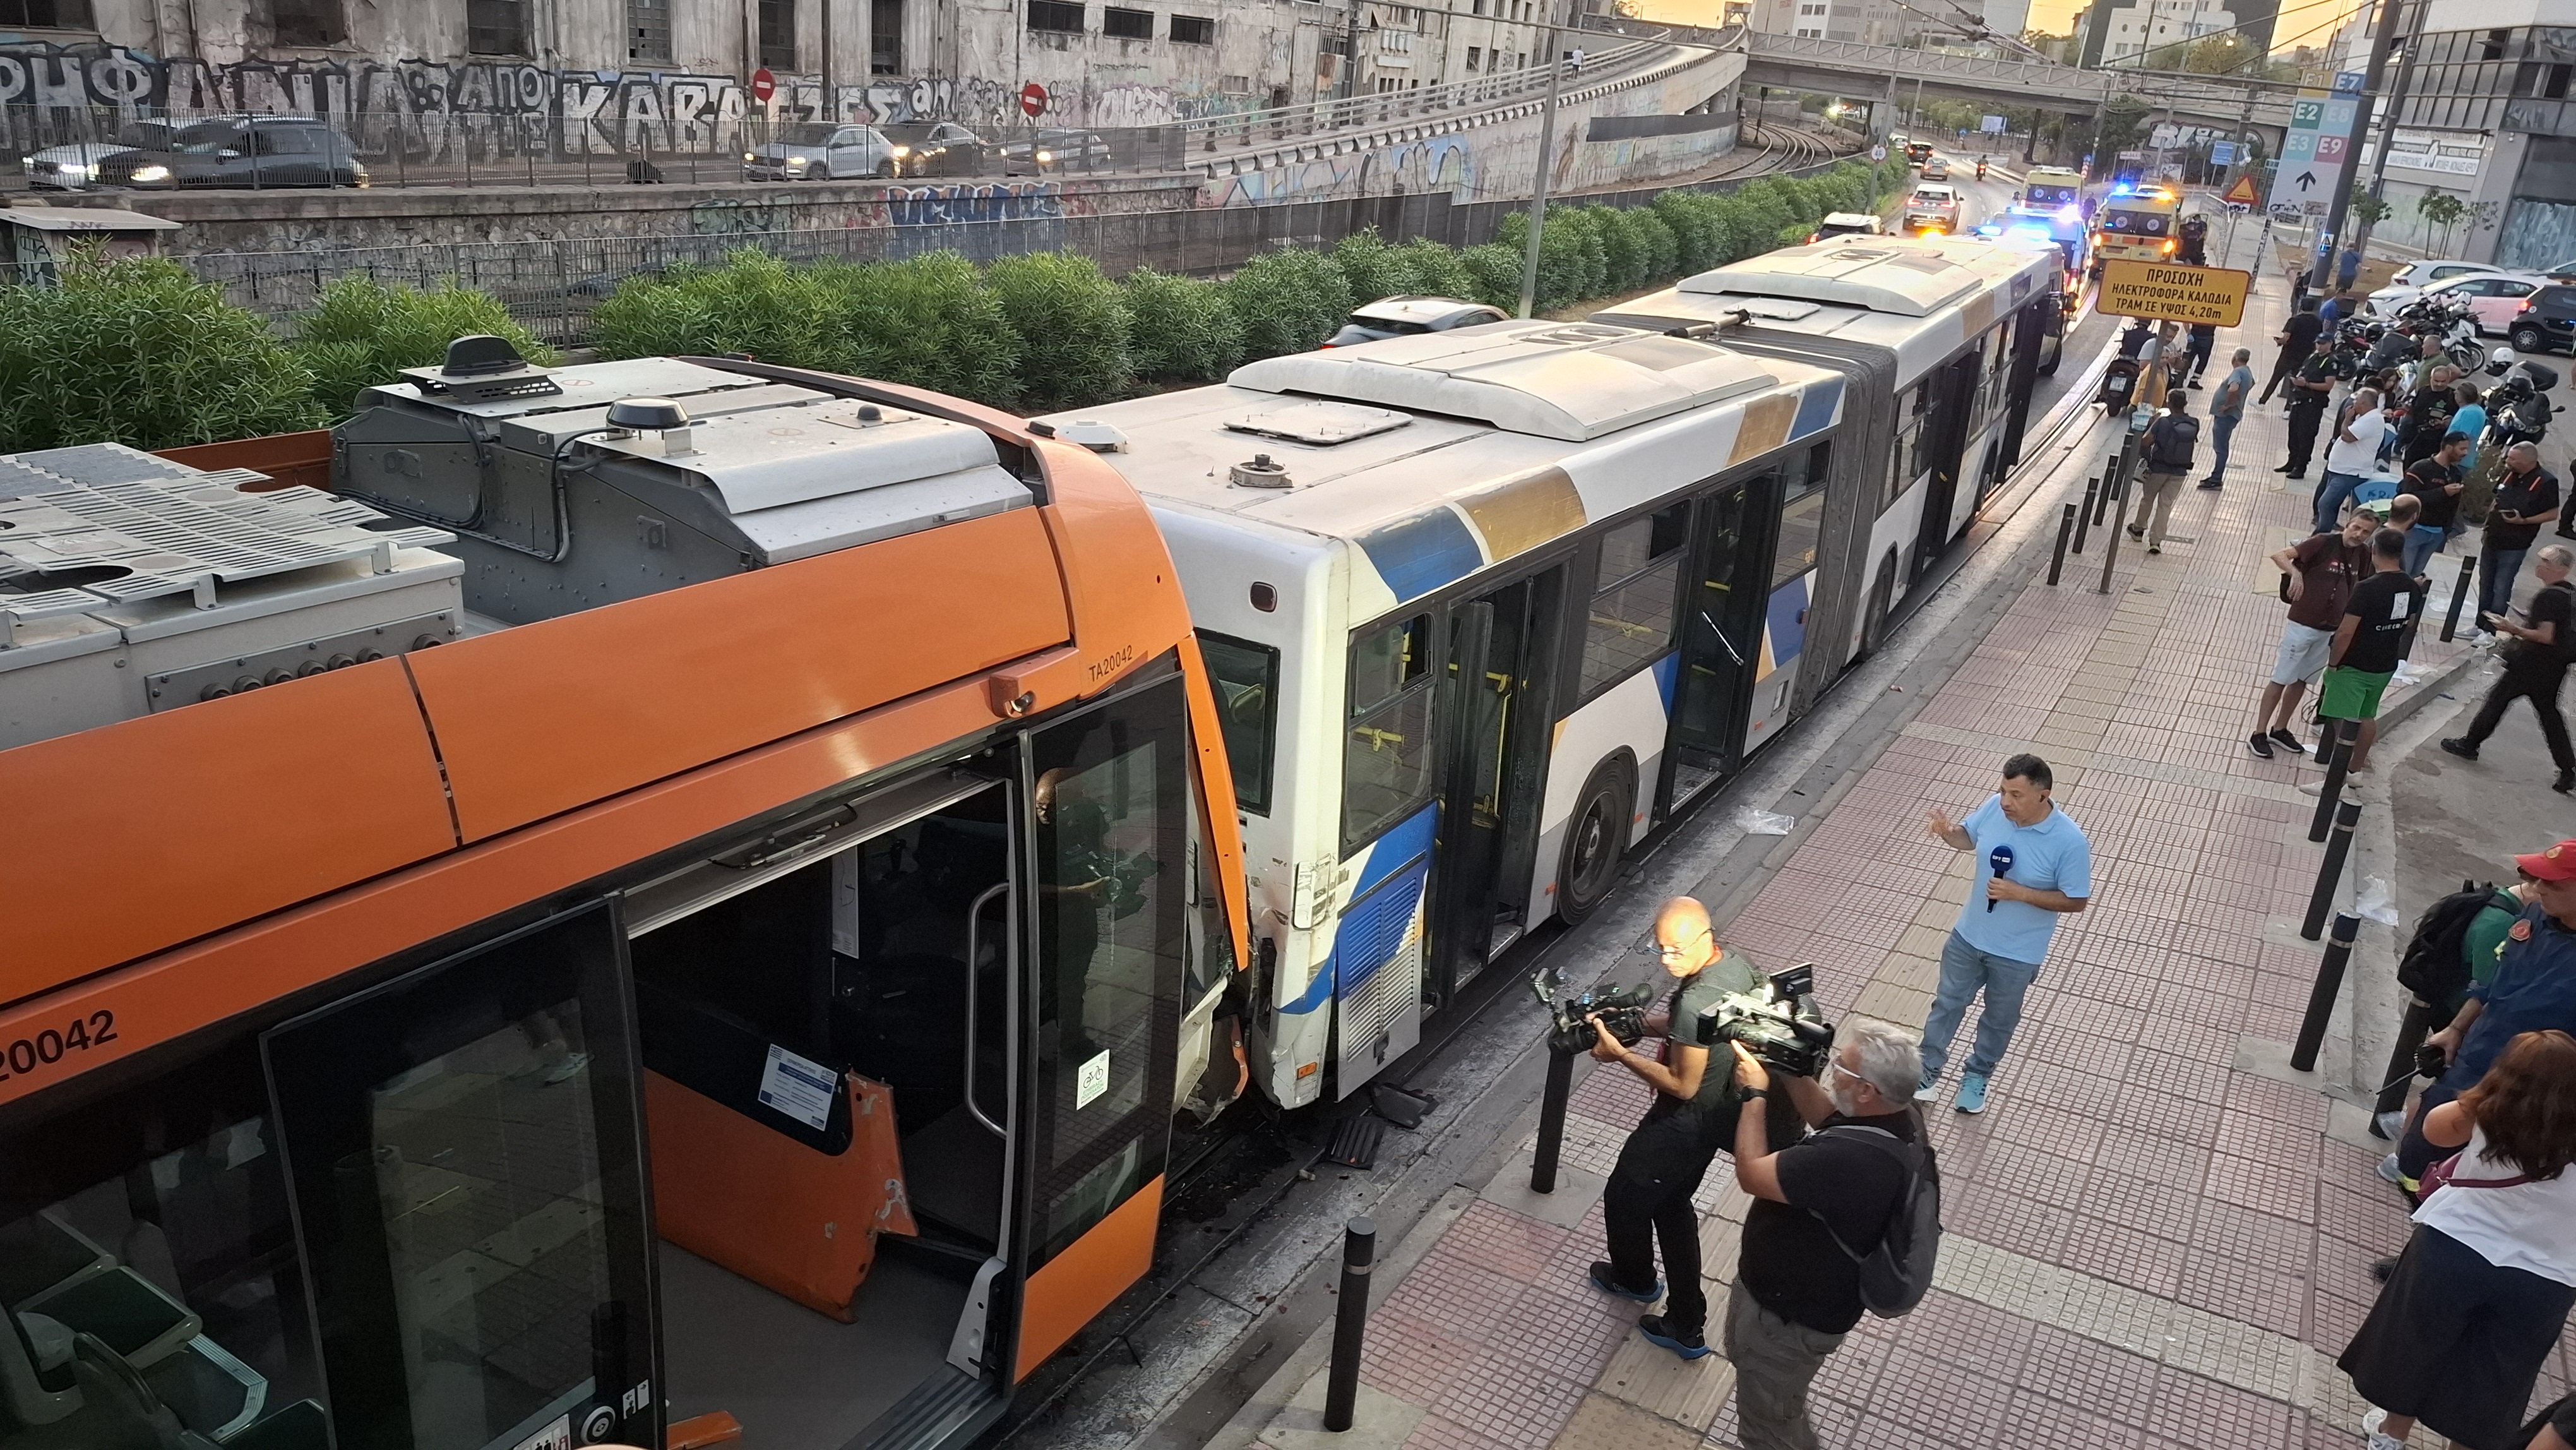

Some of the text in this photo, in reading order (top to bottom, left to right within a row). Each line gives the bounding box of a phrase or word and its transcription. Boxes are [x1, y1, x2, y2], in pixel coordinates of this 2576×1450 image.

[2305, 73, 2325, 87] E1
[2335, 74, 2360, 90] E7
[2294, 103, 2318, 121] E2
[2327, 105, 2351, 123] E8
[2286, 134, 2310, 152] E3
[2317, 137, 2342, 155] E9
[2146, 268, 2205, 287] ΠΡΟΣΟΧΗ
[2111, 283, 2232, 306] ΗΛΕΚΤΡΟΦΟΡΑ ΚΑΛΩΔΙΑ
[2116, 297, 2222, 320] ΤΡΑΜ ΣΕ ΥΨΟΣ 4,20m
[1088, 644, 1133, 682] TA20042
